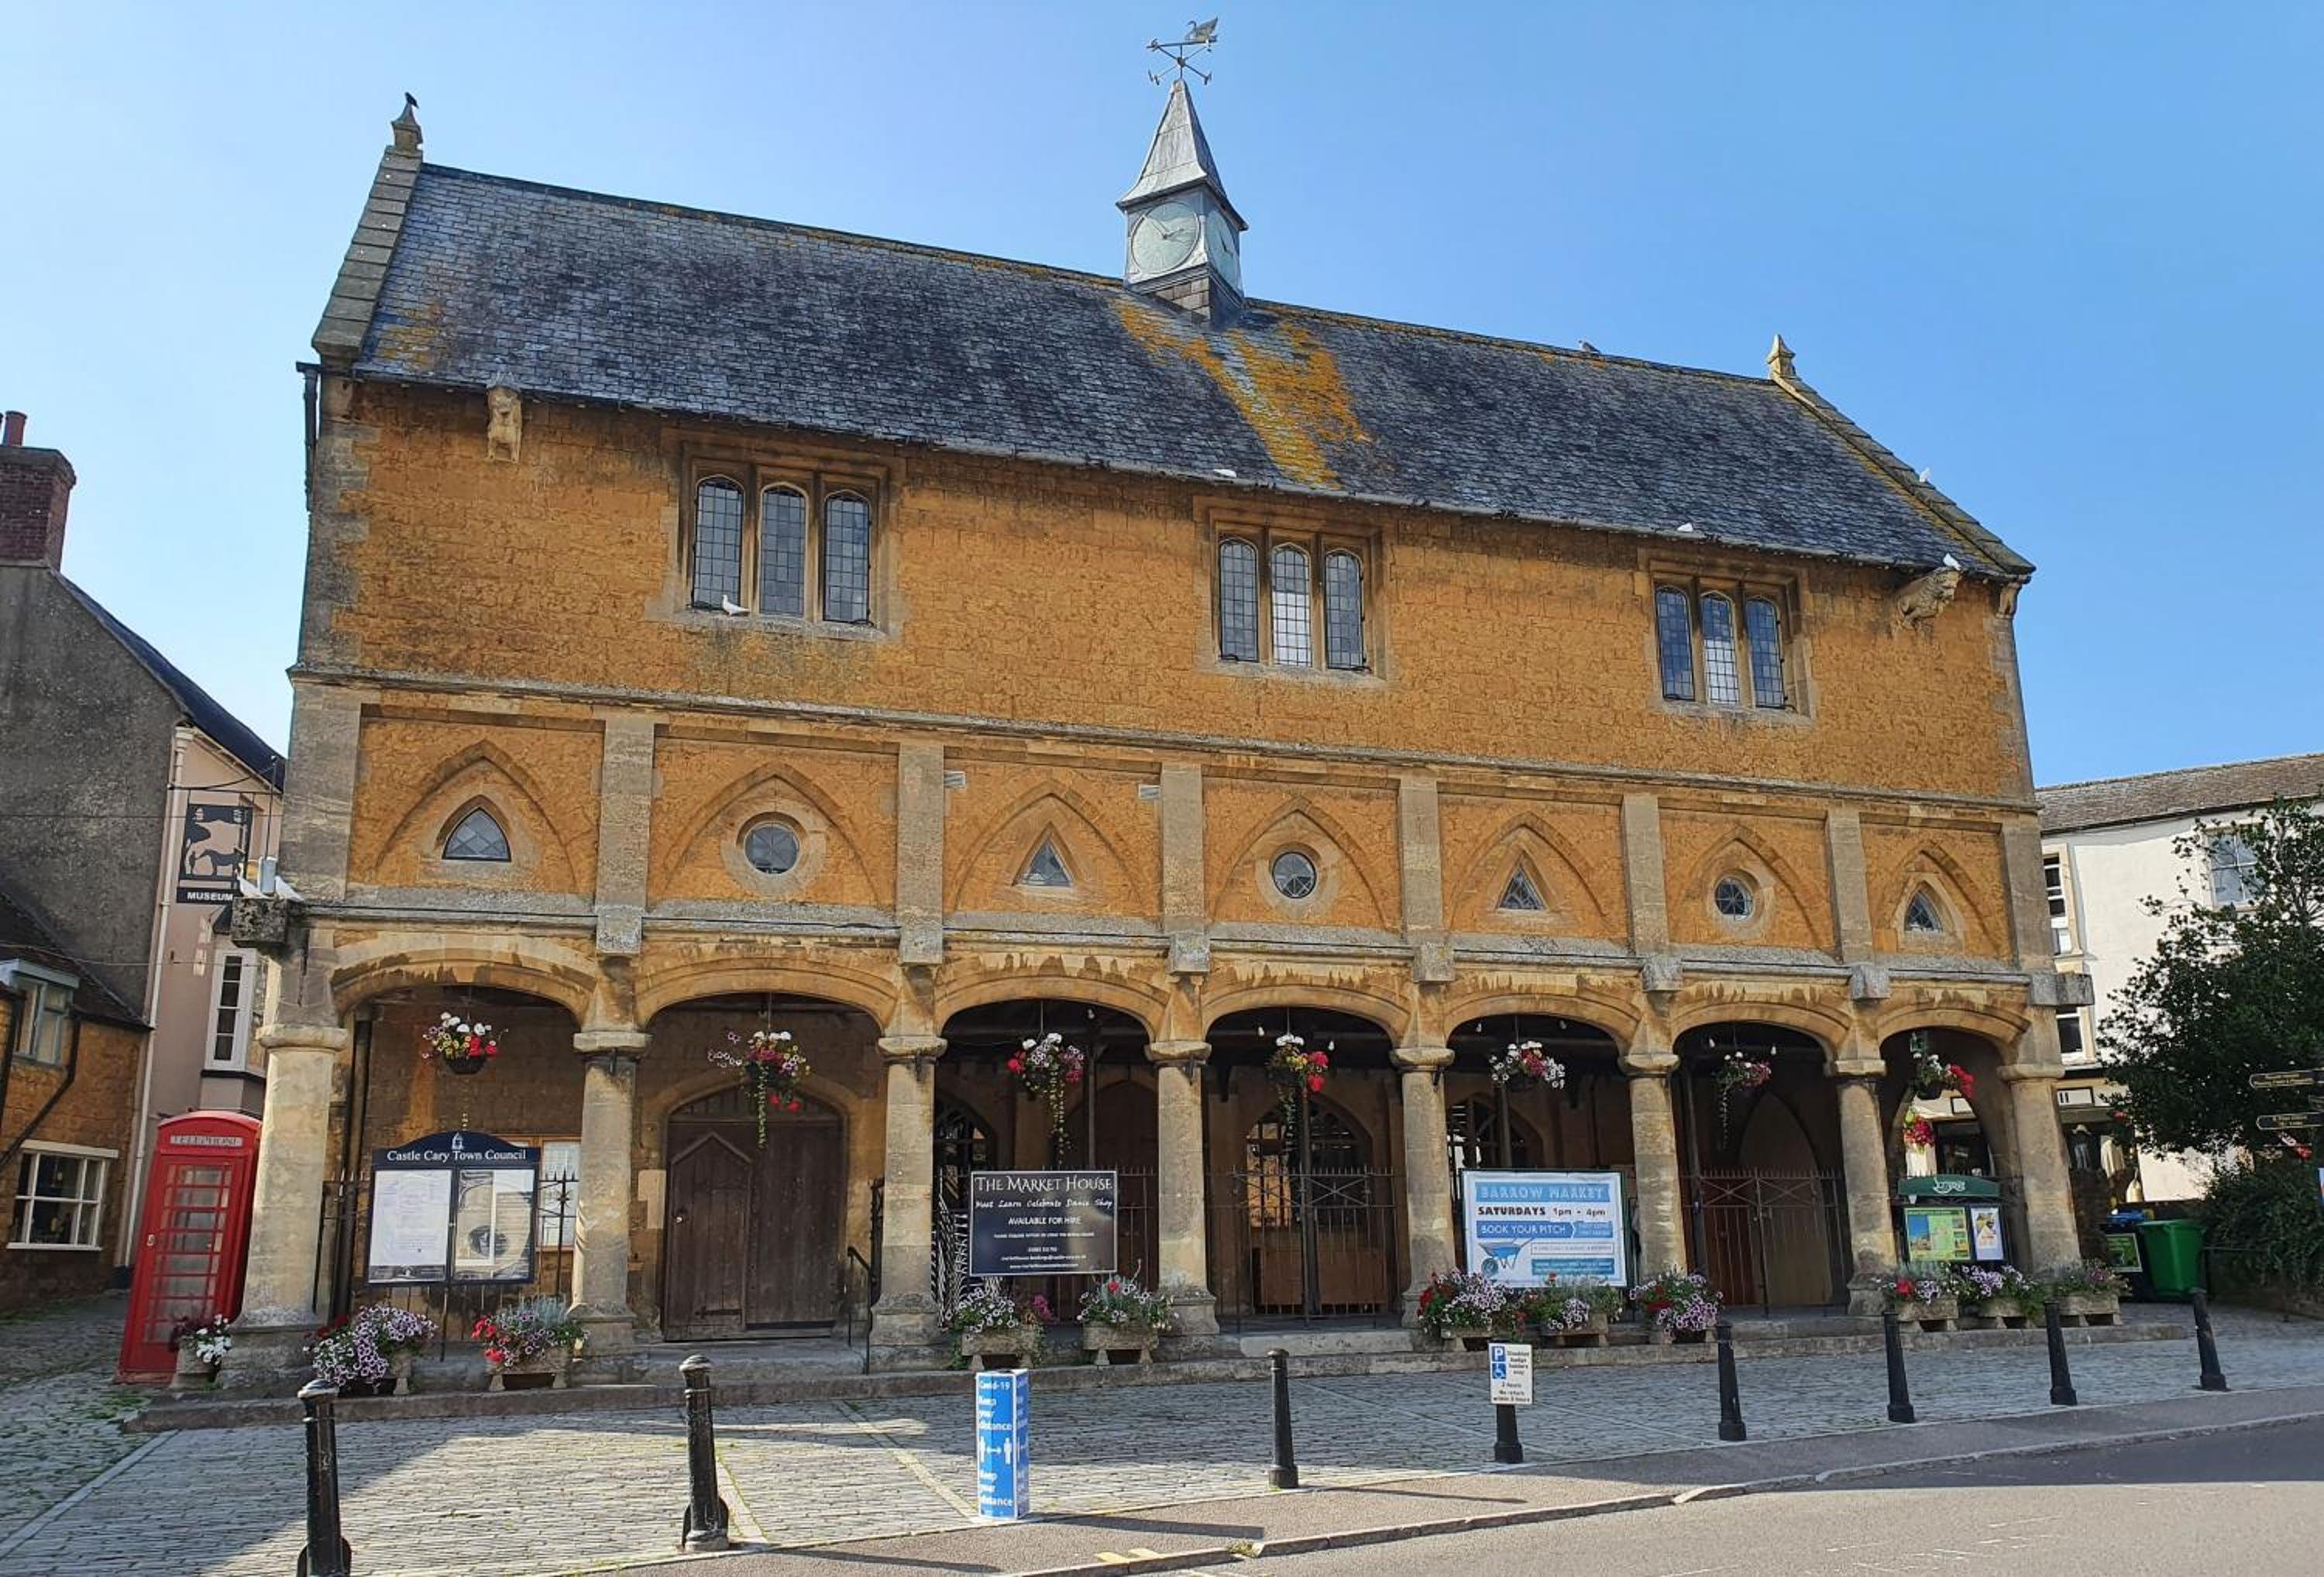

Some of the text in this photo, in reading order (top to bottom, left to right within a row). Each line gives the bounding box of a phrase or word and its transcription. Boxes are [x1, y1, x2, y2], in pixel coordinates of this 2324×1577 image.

[187, 892, 233, 901] MUSEUM
[387, 1149, 526, 1162] Castle Cary Town Council
[975, 1175, 1113, 1193] THE MARKET HOUSE
[1480, 1187, 1603, 1198] BARROW MARKET
[1027, 1199, 1062, 1208] Celebrate
[1478, 1206, 1546, 1215] SATURDAYS
[1553, 1208, 1572, 1217] 1pm
[1586, 1208, 1606, 1217] 4pm
[1481, 1224, 1566, 1234] BOOK YOUR PITCH
[1494, 1348, 1504, 1361] P
